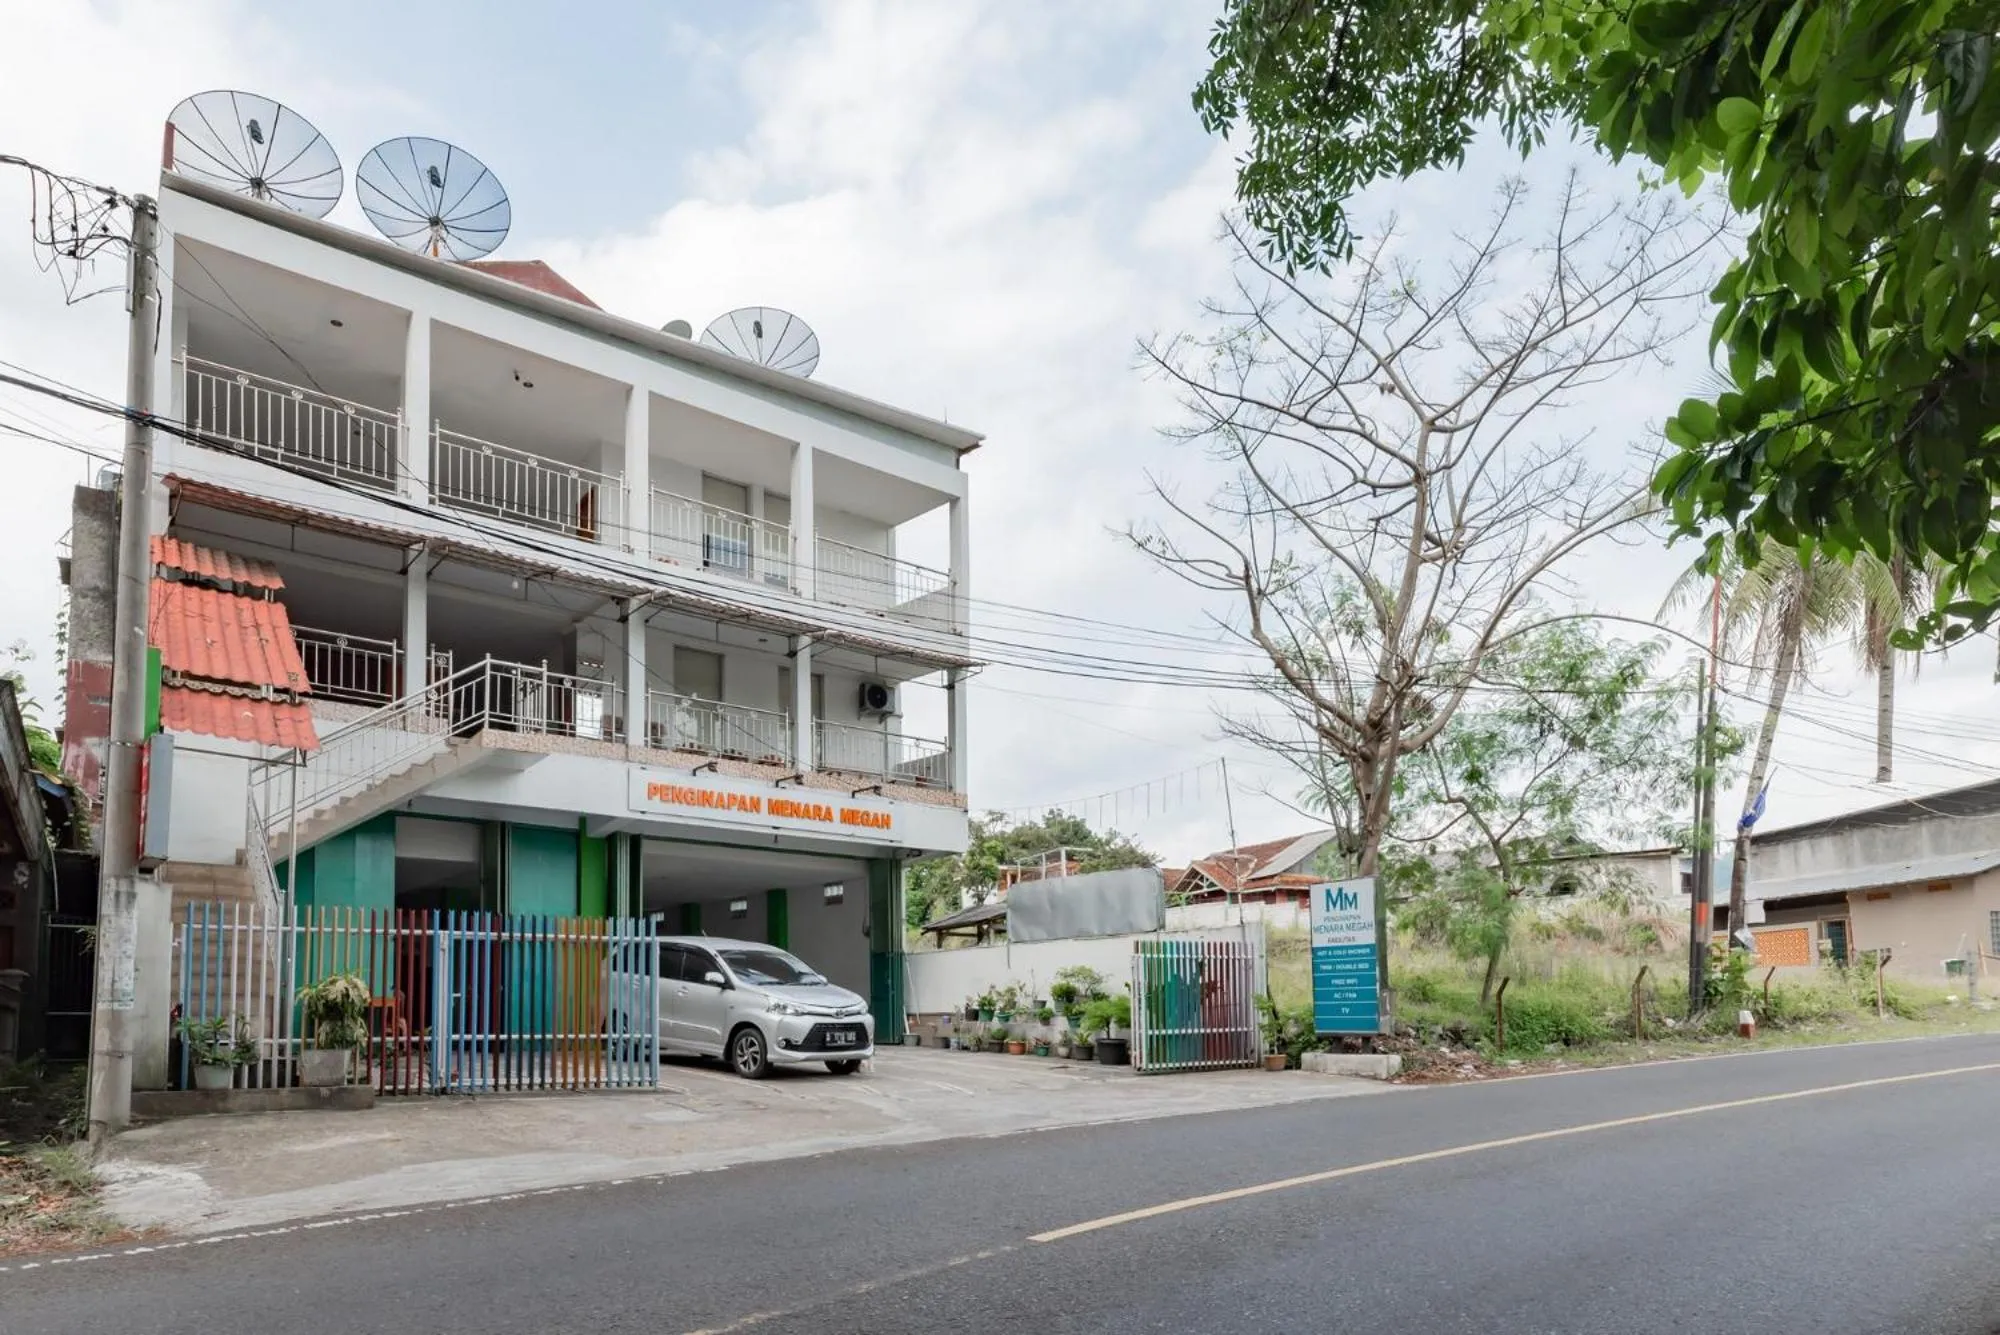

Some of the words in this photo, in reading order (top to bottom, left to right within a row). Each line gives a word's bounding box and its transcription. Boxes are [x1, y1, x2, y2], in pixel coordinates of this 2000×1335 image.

[647, 782, 761, 814] PENGINAPAN
[767, 797, 834, 823] MENARA
[840, 807, 892, 829] MEGAH
[1313, 923, 1345, 934] MENARA
[1346, 921, 1373, 932] MEGAH
